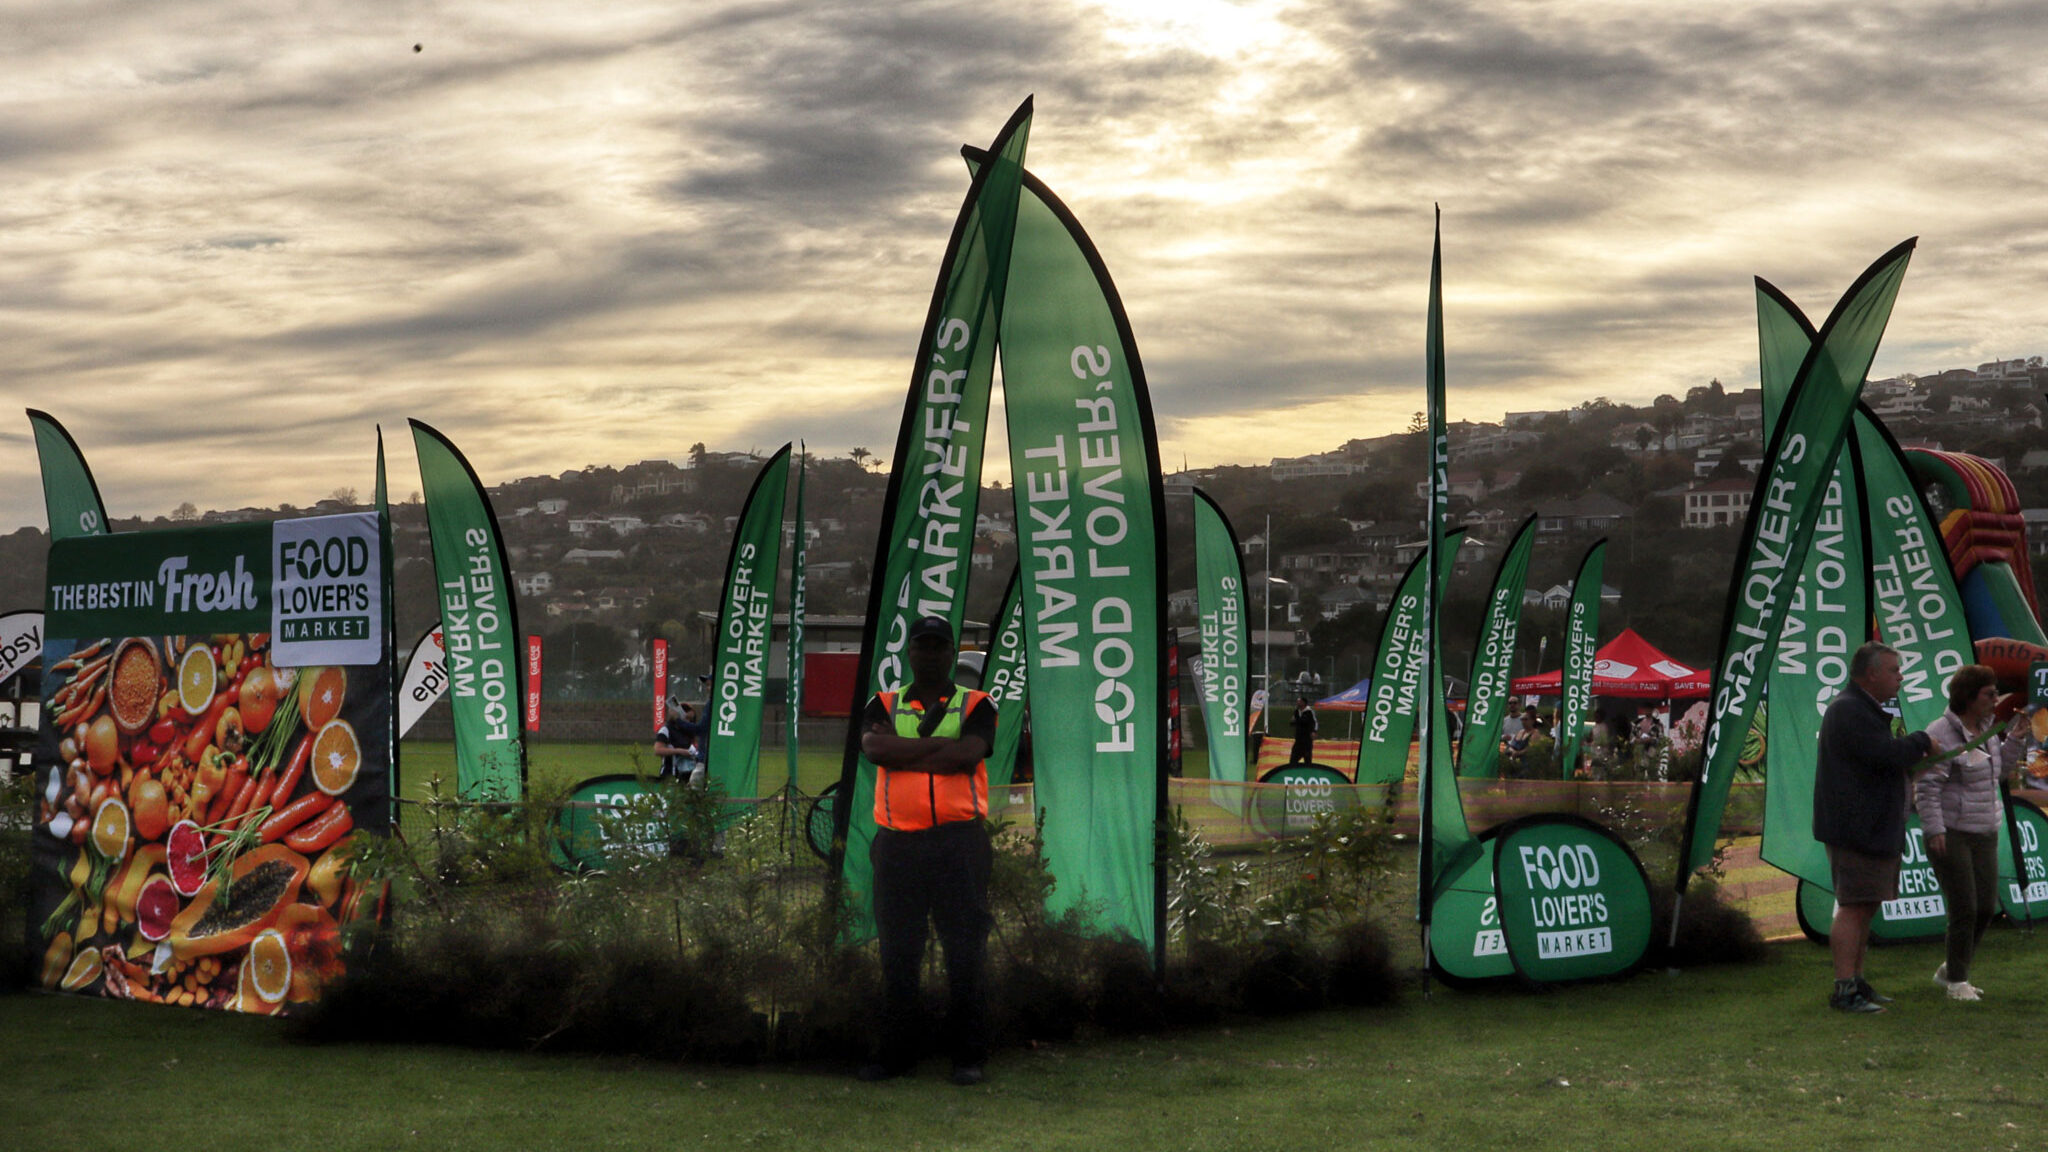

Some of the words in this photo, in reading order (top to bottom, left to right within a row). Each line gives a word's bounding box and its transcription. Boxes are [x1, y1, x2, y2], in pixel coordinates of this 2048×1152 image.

[52, 585, 85, 611] THE
[90, 580, 131, 609] BEST
[134, 580, 153, 607] IN
[158, 555, 258, 613] Fresh
[280, 536, 369, 582] FOOD
[280, 583, 369, 614] LOVER'S
[727, 543, 756, 653] LOVER'S
[284, 620, 365, 638] MARKET
[743, 586, 769, 697] MARKET
[1382, 595, 1417, 682] LOVER'S
[1472, 671, 1493, 726] FOOD
[1484, 588, 1510, 667] LOVER'S
[1495, 617, 1517, 697] MARKET
[1569, 602, 1585, 677] LOVER'S
[718, 661, 740, 736] FOOD
[1396, 630, 1424, 716] MARKET
[1580, 634, 1595, 710] MARKET
[1674, 682, 1694, 690] SAVE
[1369, 684, 1397, 743] FOOD
[1567, 680, 1579, 737] FOOD
[1284, 776, 1332, 797] FOOD
[1519, 844, 1600, 889] FOOD
[1531, 893, 1608, 927] LOVER'S
[1884, 899, 1940, 916] MARKET
[1541, 932, 1607, 954] MARKET
